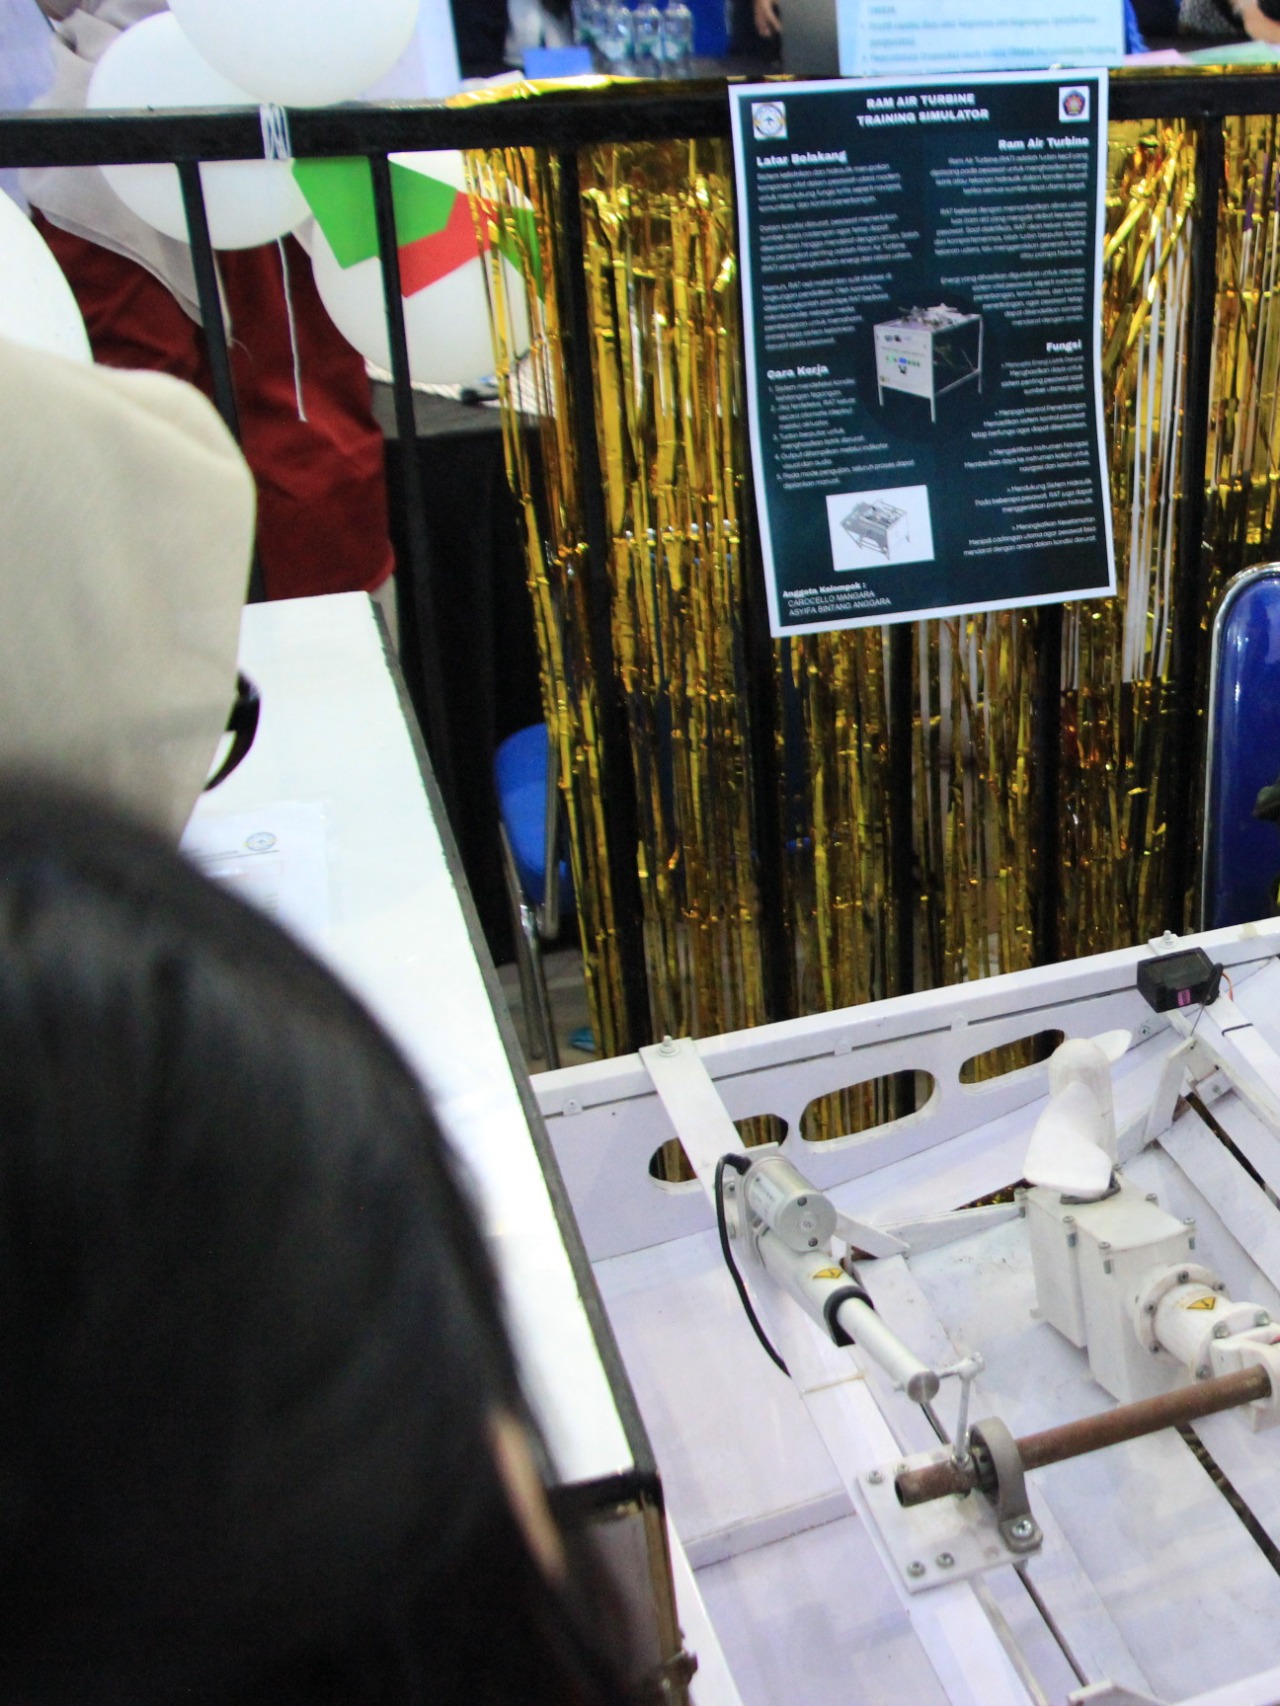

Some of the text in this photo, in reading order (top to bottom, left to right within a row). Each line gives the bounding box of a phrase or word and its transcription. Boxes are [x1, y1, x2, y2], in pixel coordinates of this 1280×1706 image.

[866, 92, 975, 109] RAM AIR TURBINE
[857, 108, 989, 126] TRAINING SIMULATOR
[998, 135, 1089, 150] Ram Air Turbine
[756, 150, 847, 168] Latar Belakang
[1046, 339, 1081, 354] Fungsi
[767, 364, 829, 380] Cara Kerja
[783, 587, 818, 600] Anggota
[820, 582, 861, 595] Kelompok
[836, 590, 875, 601] MANGARA
[789, 597, 891, 616] ASYIFA BINTANG ANGGARA
